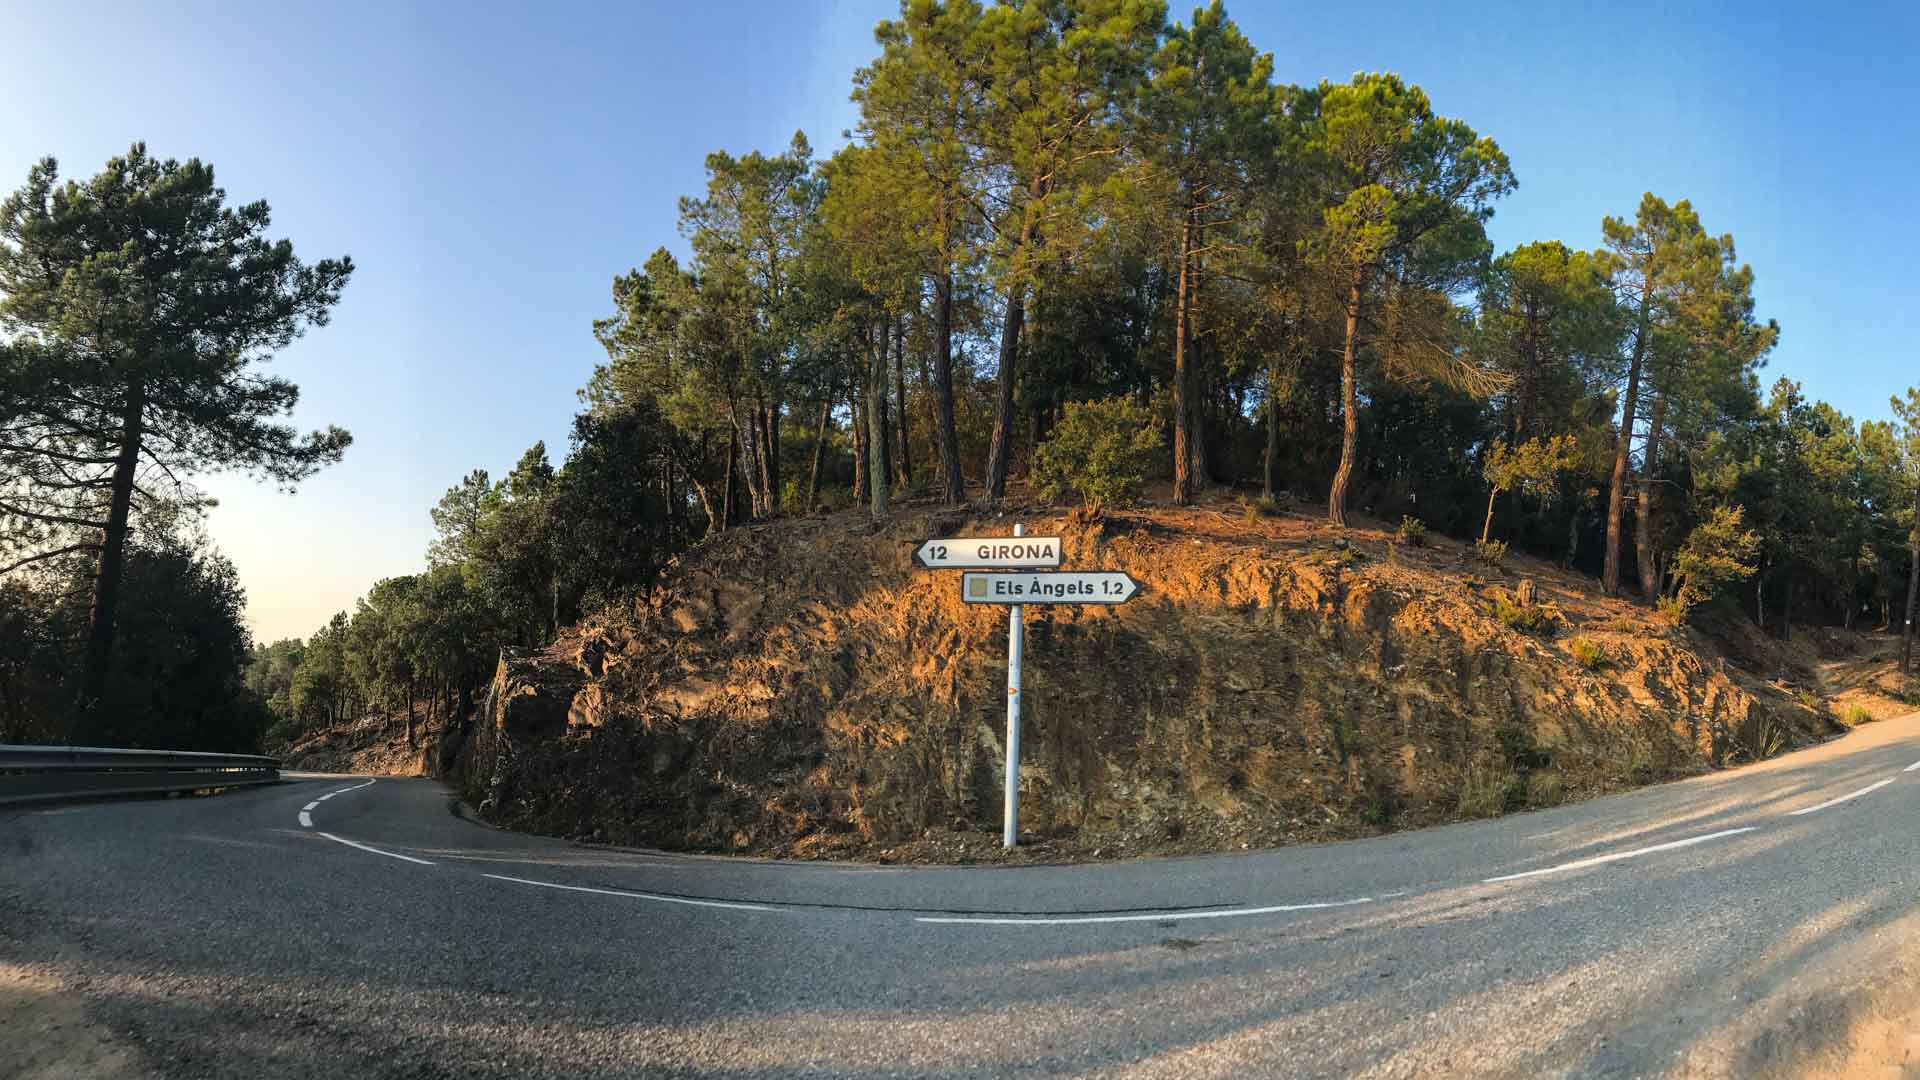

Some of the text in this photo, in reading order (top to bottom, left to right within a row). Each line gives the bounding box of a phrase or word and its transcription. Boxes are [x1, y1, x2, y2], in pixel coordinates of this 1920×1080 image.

[928, 544, 1054, 560] 12 GIRONA
[995, 580, 1023, 595] Els
